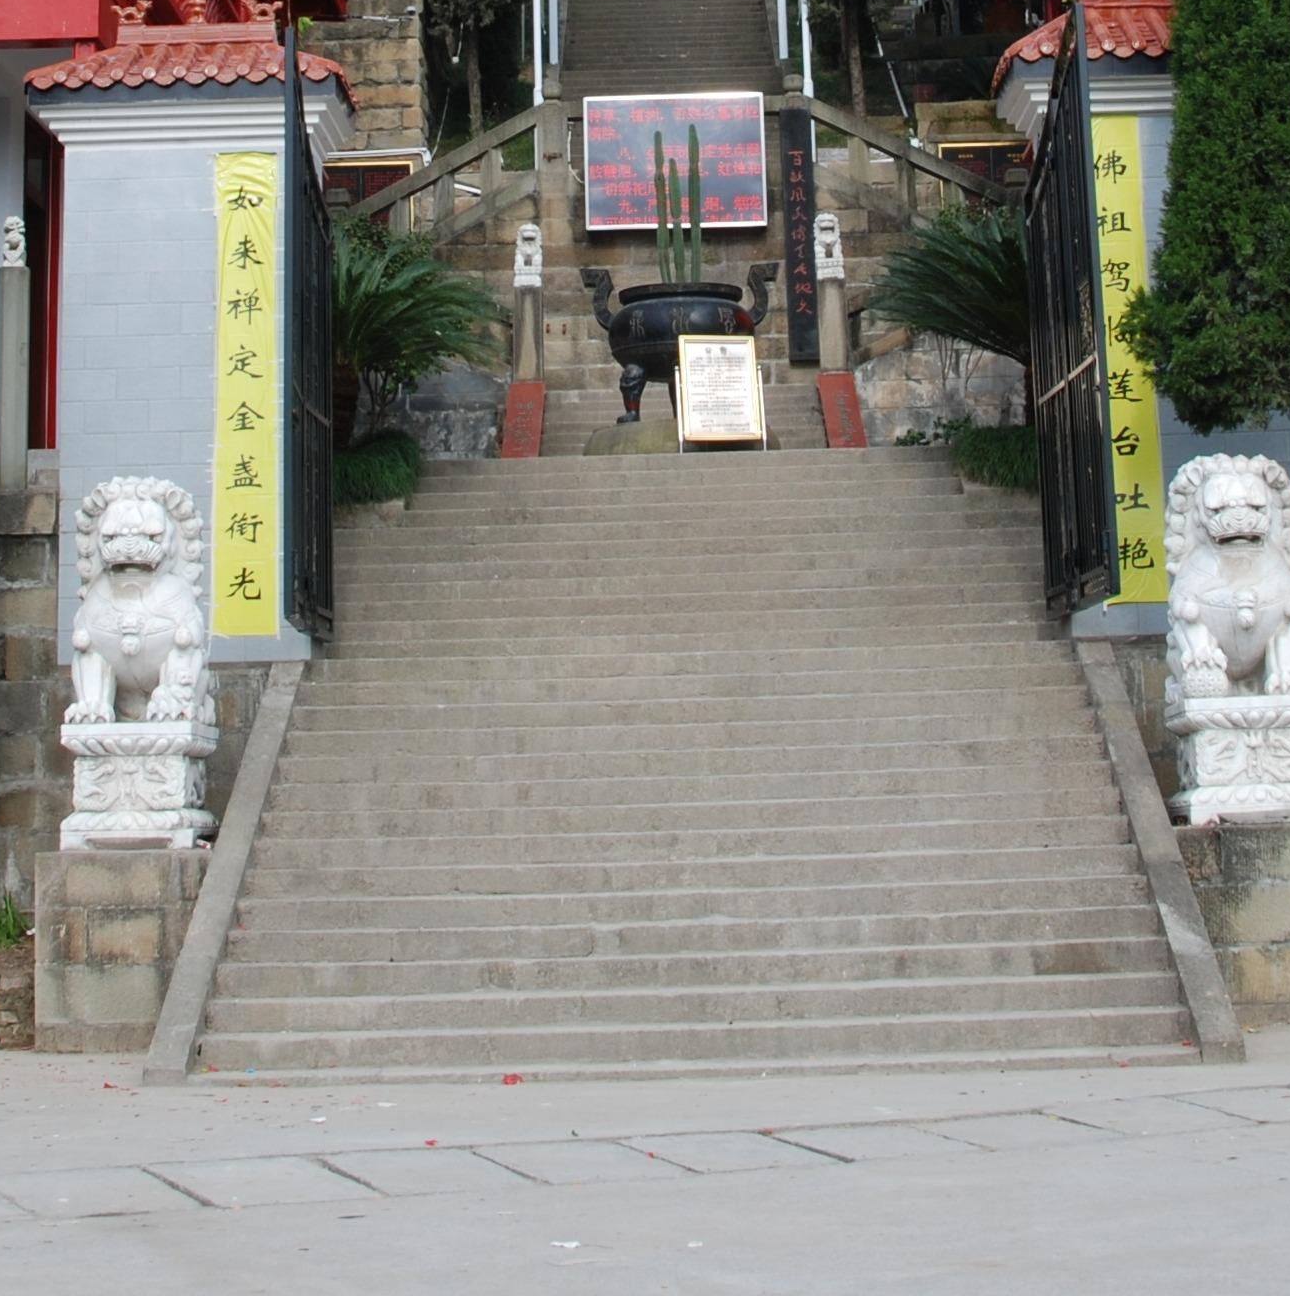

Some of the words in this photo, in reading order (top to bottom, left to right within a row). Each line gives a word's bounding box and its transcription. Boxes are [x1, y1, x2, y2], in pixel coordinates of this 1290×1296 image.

[226, 185, 264, 600] 如来禅定金盏衔光
